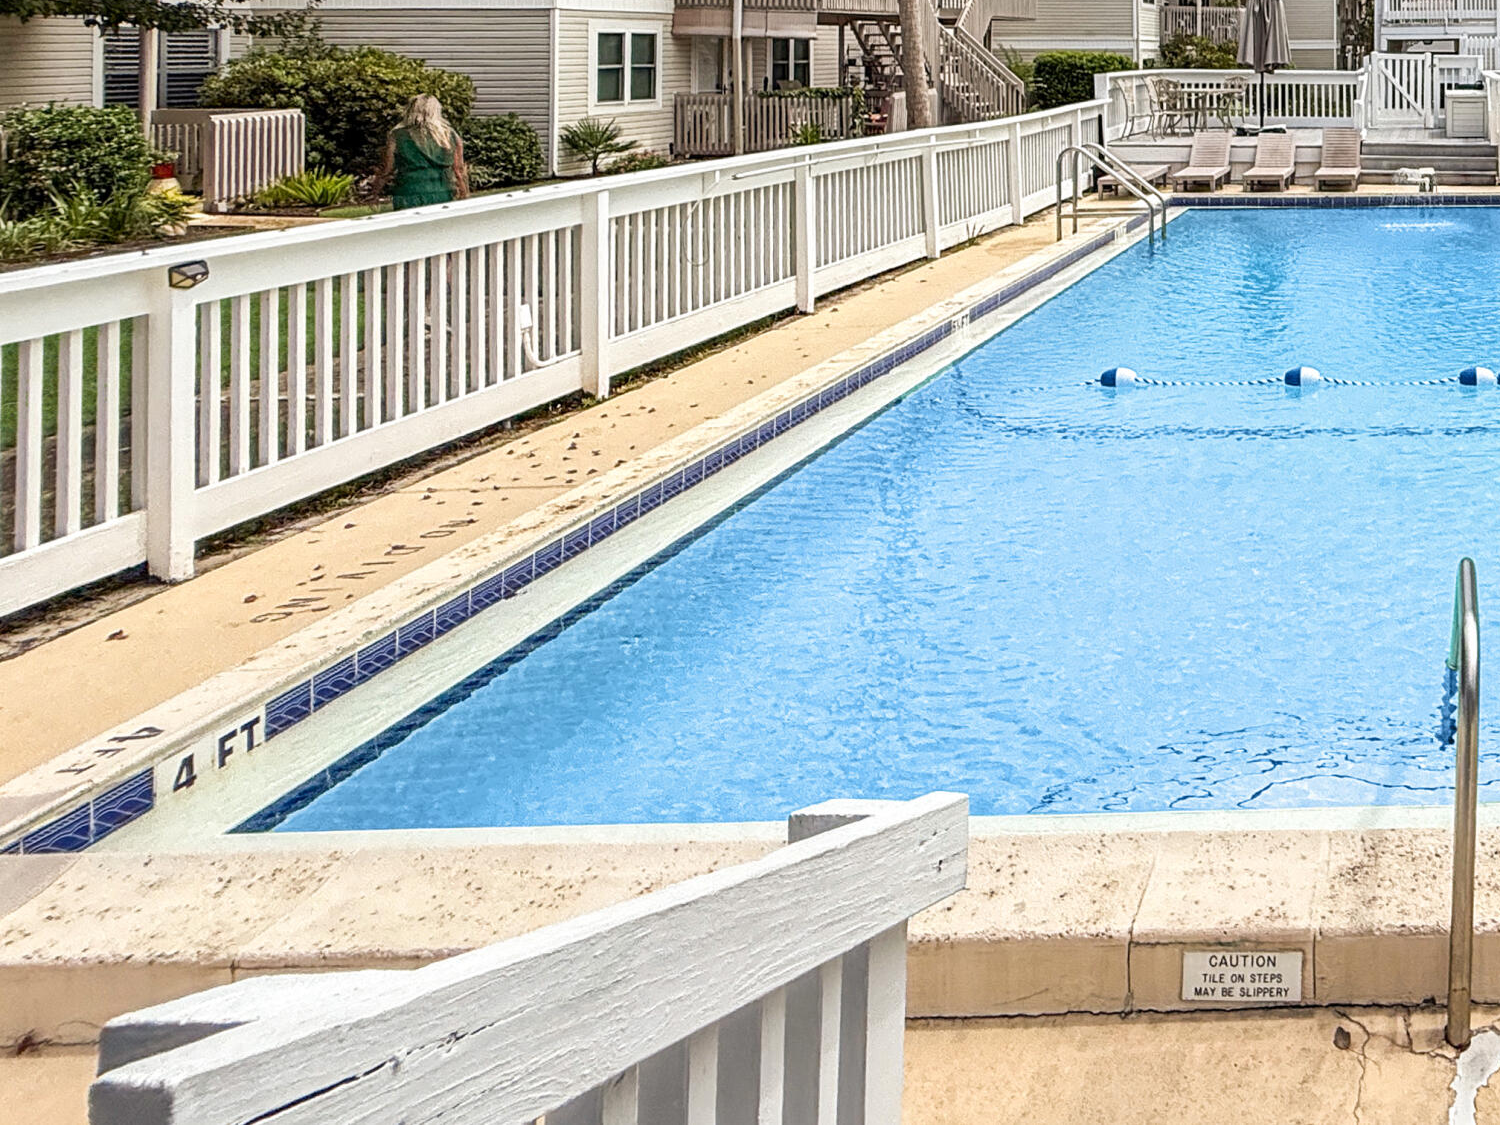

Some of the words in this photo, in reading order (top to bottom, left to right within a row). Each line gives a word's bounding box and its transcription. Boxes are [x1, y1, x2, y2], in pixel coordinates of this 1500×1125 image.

[249, 544, 426, 623] DIVING
[172, 752, 198, 793] 4
[217, 715, 261, 770] FT
[1208, 955, 1277, 968] CAUTION
[1202, 973, 1224, 983] TILE
[1230, 973, 1245, 983] ON
[1250, 973, 1283, 983] STEPS
[1194, 987, 1217, 997] MAY
[1221, 987, 1234, 997] BE
[1239, 987, 1290, 998] SLIPPERY
